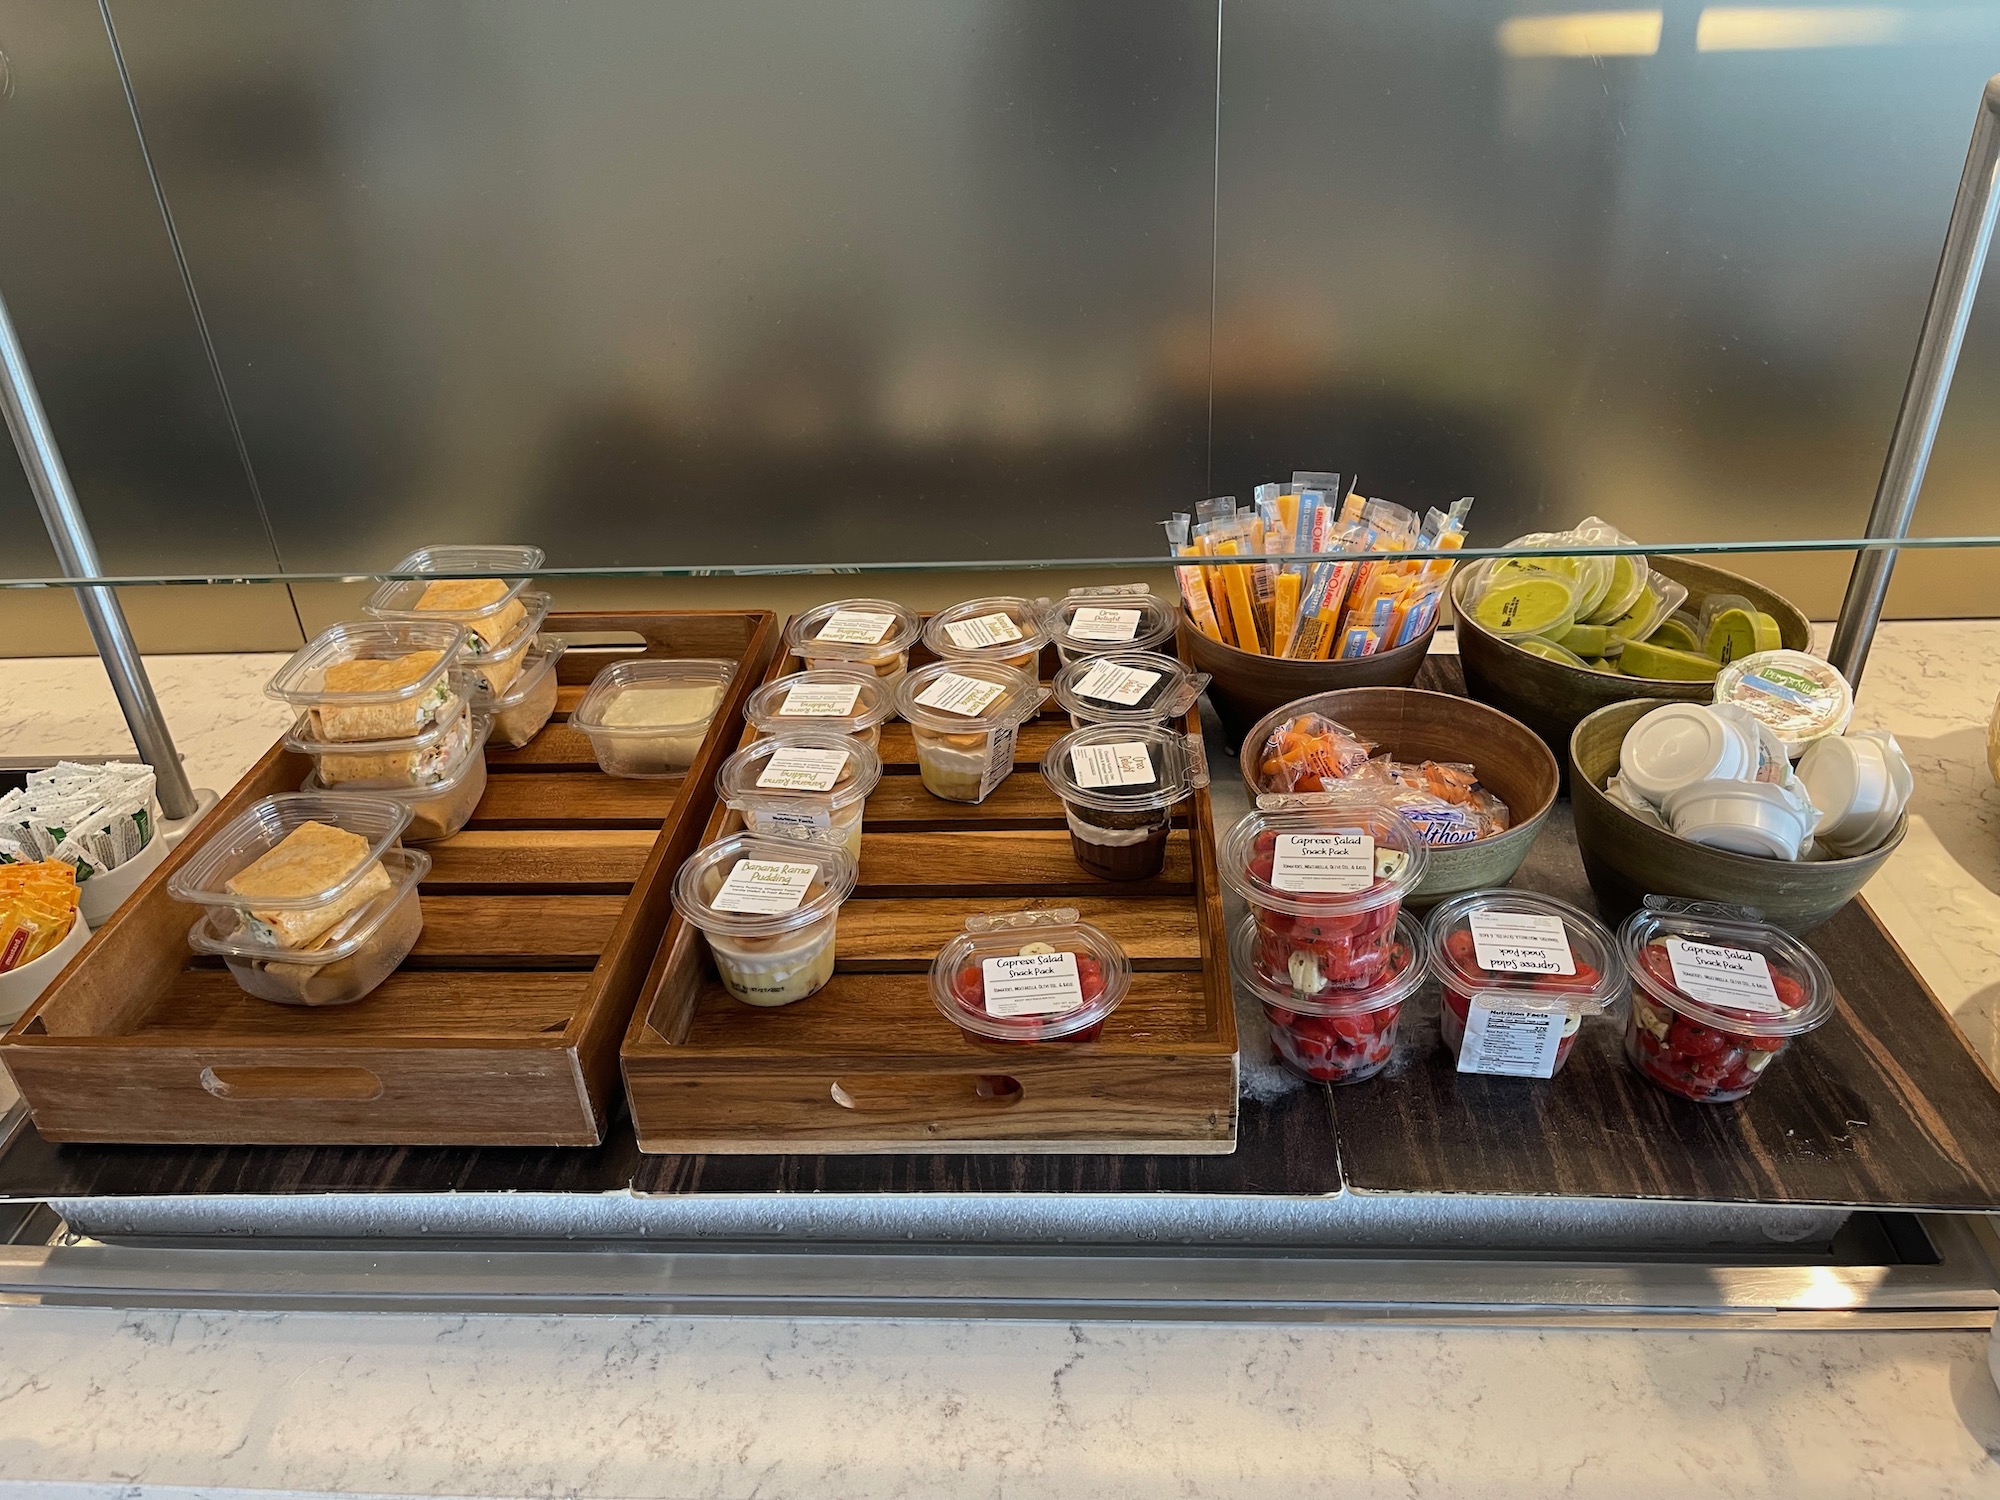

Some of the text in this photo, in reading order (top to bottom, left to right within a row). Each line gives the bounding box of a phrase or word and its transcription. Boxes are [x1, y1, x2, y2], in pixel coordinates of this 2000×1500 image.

[1314, 508, 1324, 526] LAND
[1132, 757, 1146, 770] Oreo
[781, 770, 818, 780] Pudding
[763, 778, 827, 789] Banana Rama
[1290, 836, 1361, 846] Caprese Salad
[1328, 848, 1349, 856] Pack
[741, 861, 811, 875] Banana Rama
[749, 872, 792, 885] Pudding
[1499, 948, 1546, 959] Snack Pack
[1681, 942, 1752, 962] Caprese Salad
[996, 954, 1064, 969] Caprese Salad
[1490, 959, 1560, 972] Caprese Salad
[1696, 957, 1745, 971] Snack Pack
[1009, 967, 1055, 978] Snack Pack
